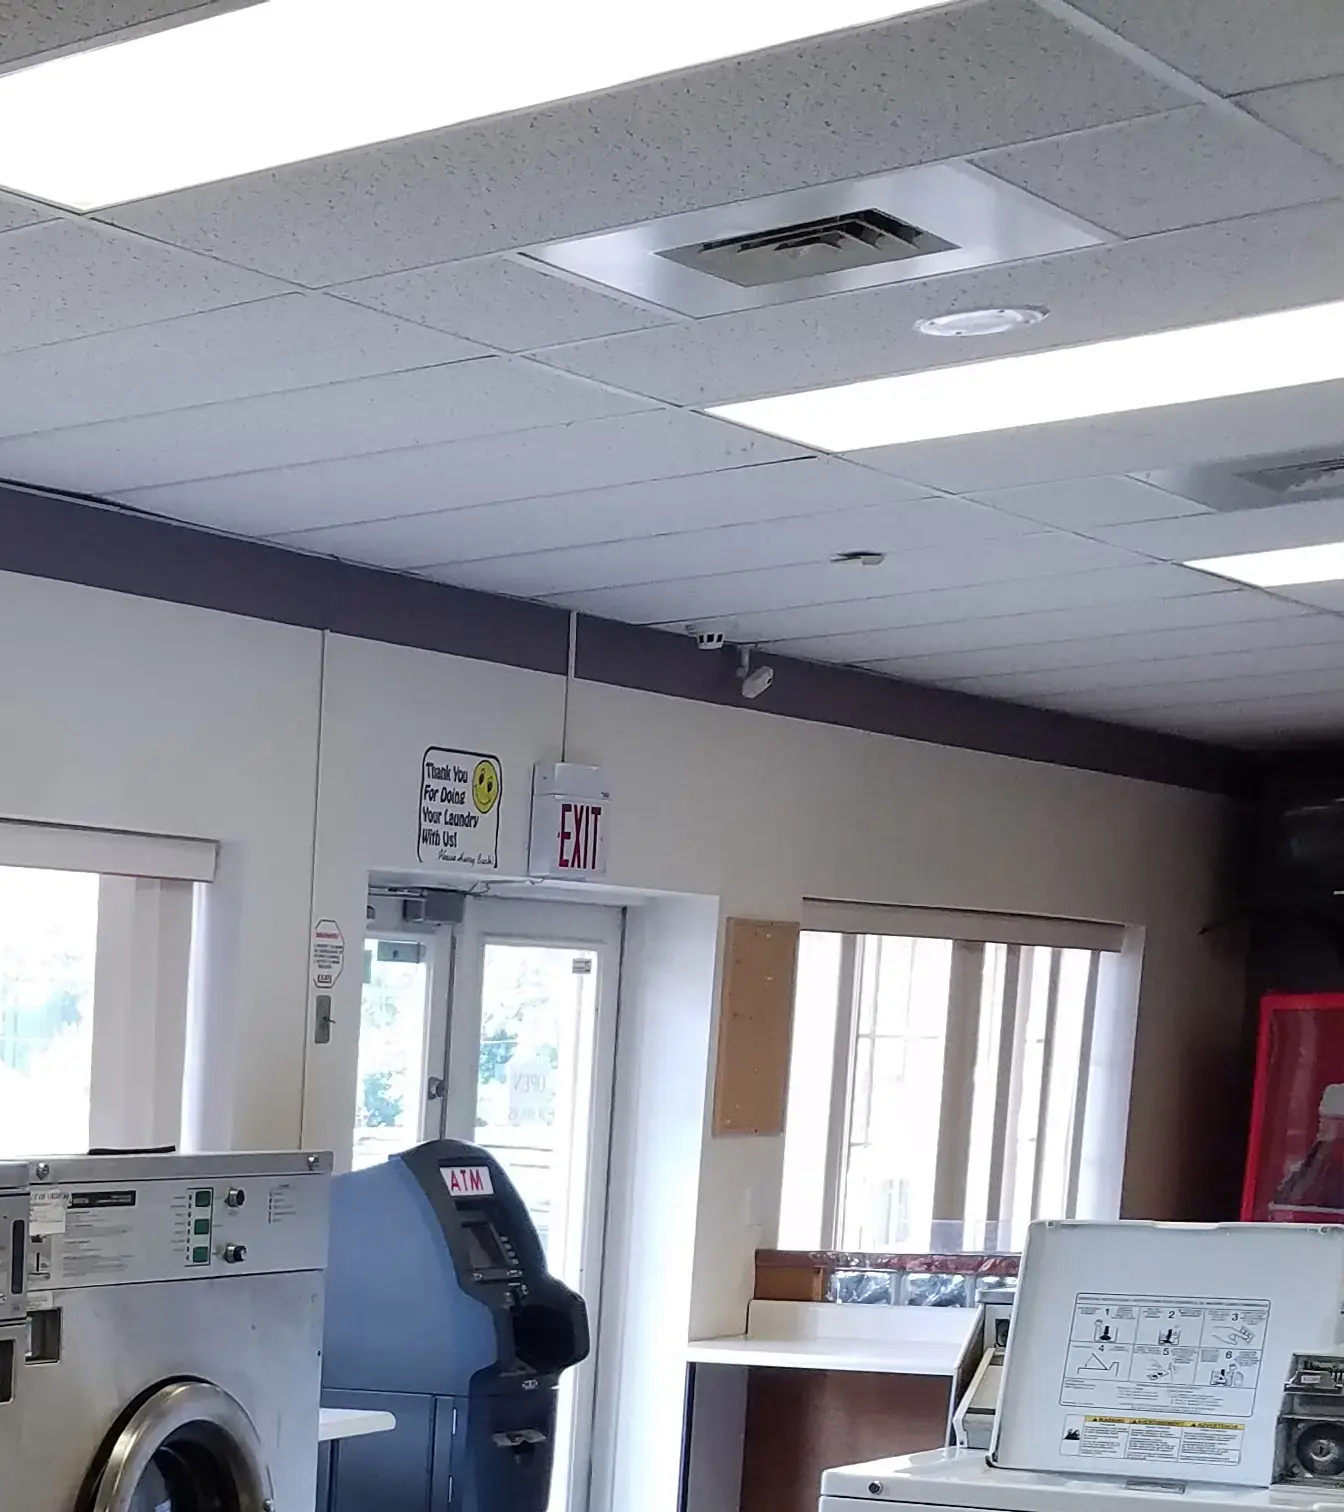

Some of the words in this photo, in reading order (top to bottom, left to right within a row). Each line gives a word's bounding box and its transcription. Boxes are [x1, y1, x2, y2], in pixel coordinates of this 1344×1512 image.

[426, 762, 451, 781] Thank
[453, 766, 469, 783] You
[424, 784, 439, 802] For
[440, 786, 466, 805] Doing
[422, 806, 442, 824] Your
[444, 808, 479, 828] Laundry
[421, 828, 441, 846] With
[442, 830, 458, 848] Us!
[558, 803, 602, 870] EXIT
[450, 1169, 484, 1191] ATM
[1105, 1308, 1111, 1316] 1
[1168, 1311, 1176, 1319] 2
[1231, 1313, 1239, 1321] 3
[1098, 1344, 1105, 1352] 4
[1162, 1347, 1170, 1356] 5
[1224, 1350, 1233, 1359] 6
